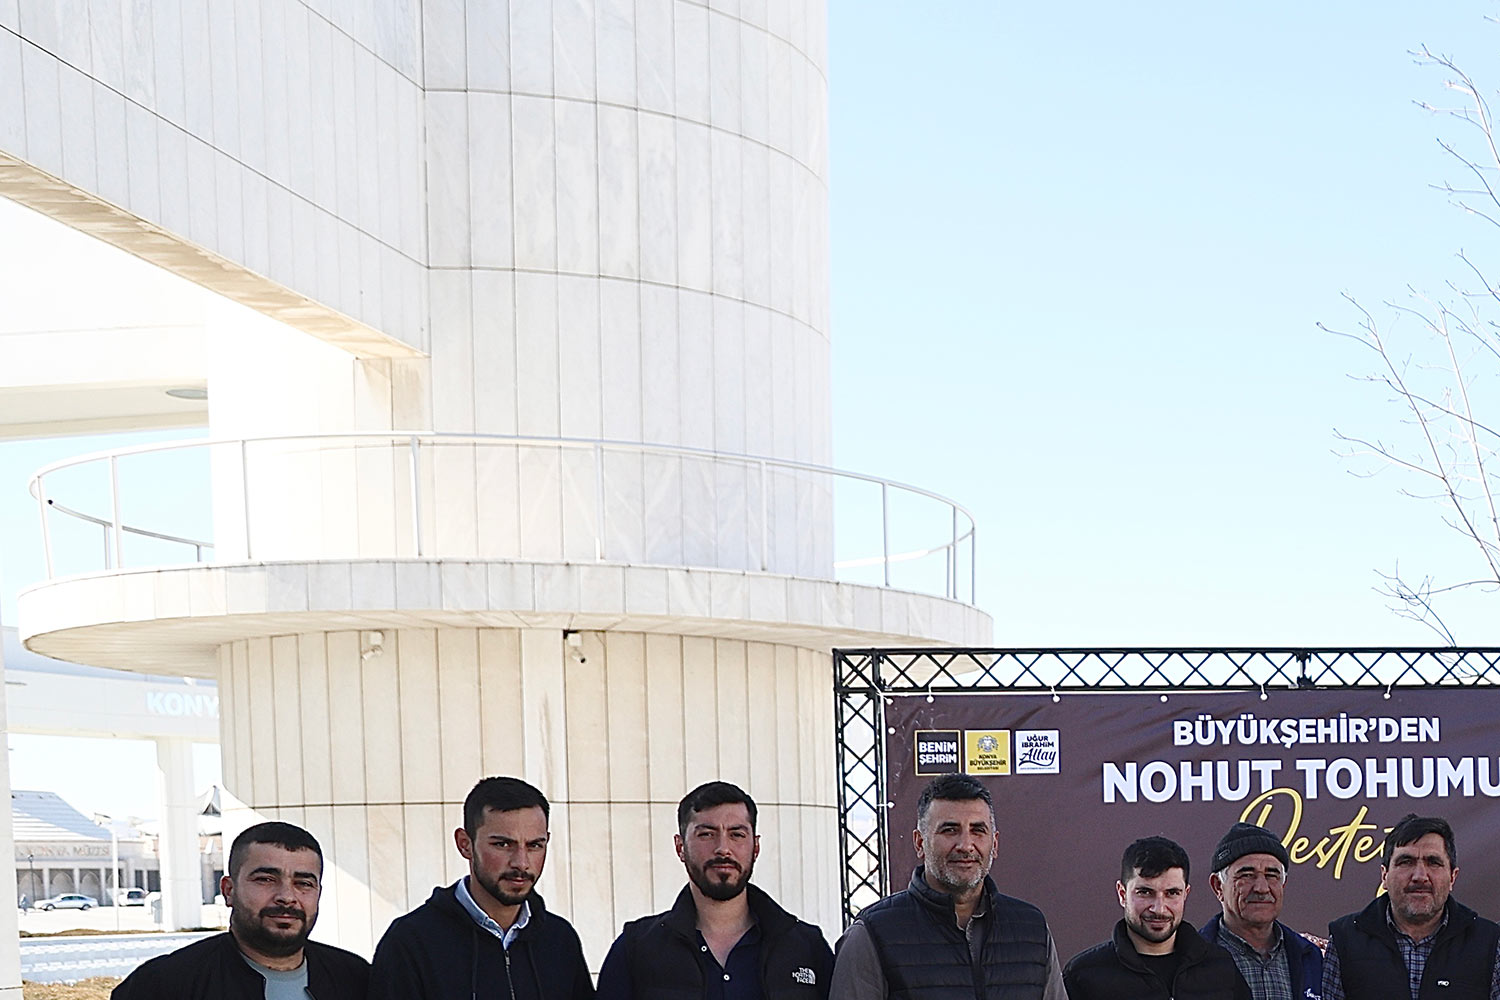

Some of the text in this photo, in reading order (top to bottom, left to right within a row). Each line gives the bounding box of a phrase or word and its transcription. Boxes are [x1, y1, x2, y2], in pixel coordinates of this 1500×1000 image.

[147, 691, 219, 718] KONY
[1026, 732, 1049, 742] UĞUR
[1172, 713, 1440, 749] BÜYÜKŞEHİR’DEN
[919, 741, 957, 753] BENİM
[919, 753, 957, 766] ŞEHRİM
[1019, 748, 1057, 766] Altay
[1102, 760, 1281, 803] NOHUT
